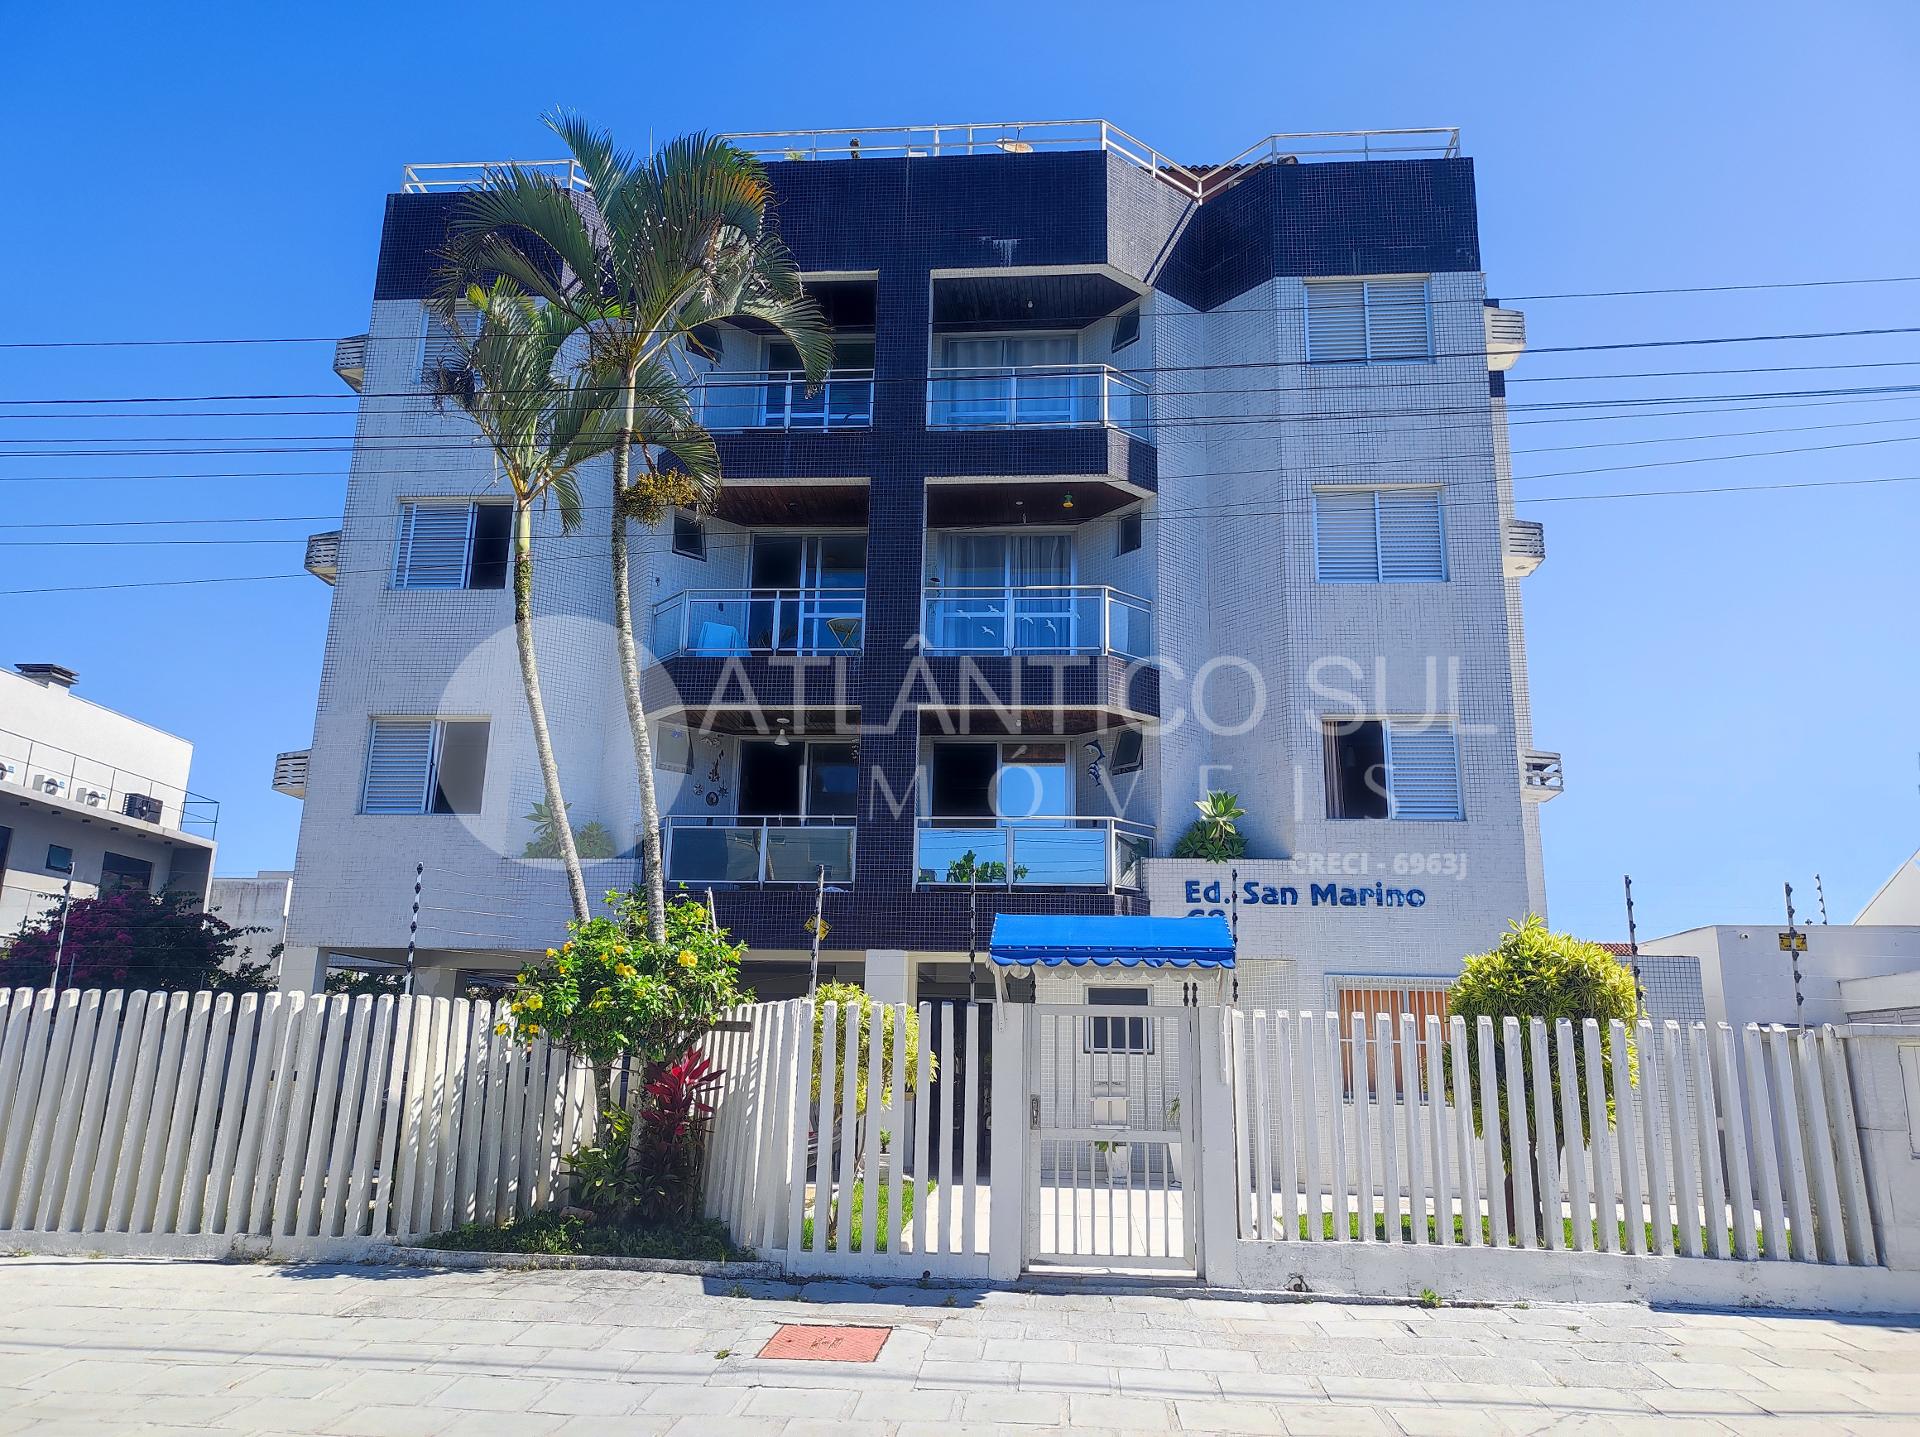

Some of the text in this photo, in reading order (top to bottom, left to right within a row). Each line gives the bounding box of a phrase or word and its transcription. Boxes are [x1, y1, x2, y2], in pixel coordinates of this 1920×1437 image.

[1185, 880, 1426, 907] Ed. San Marino
